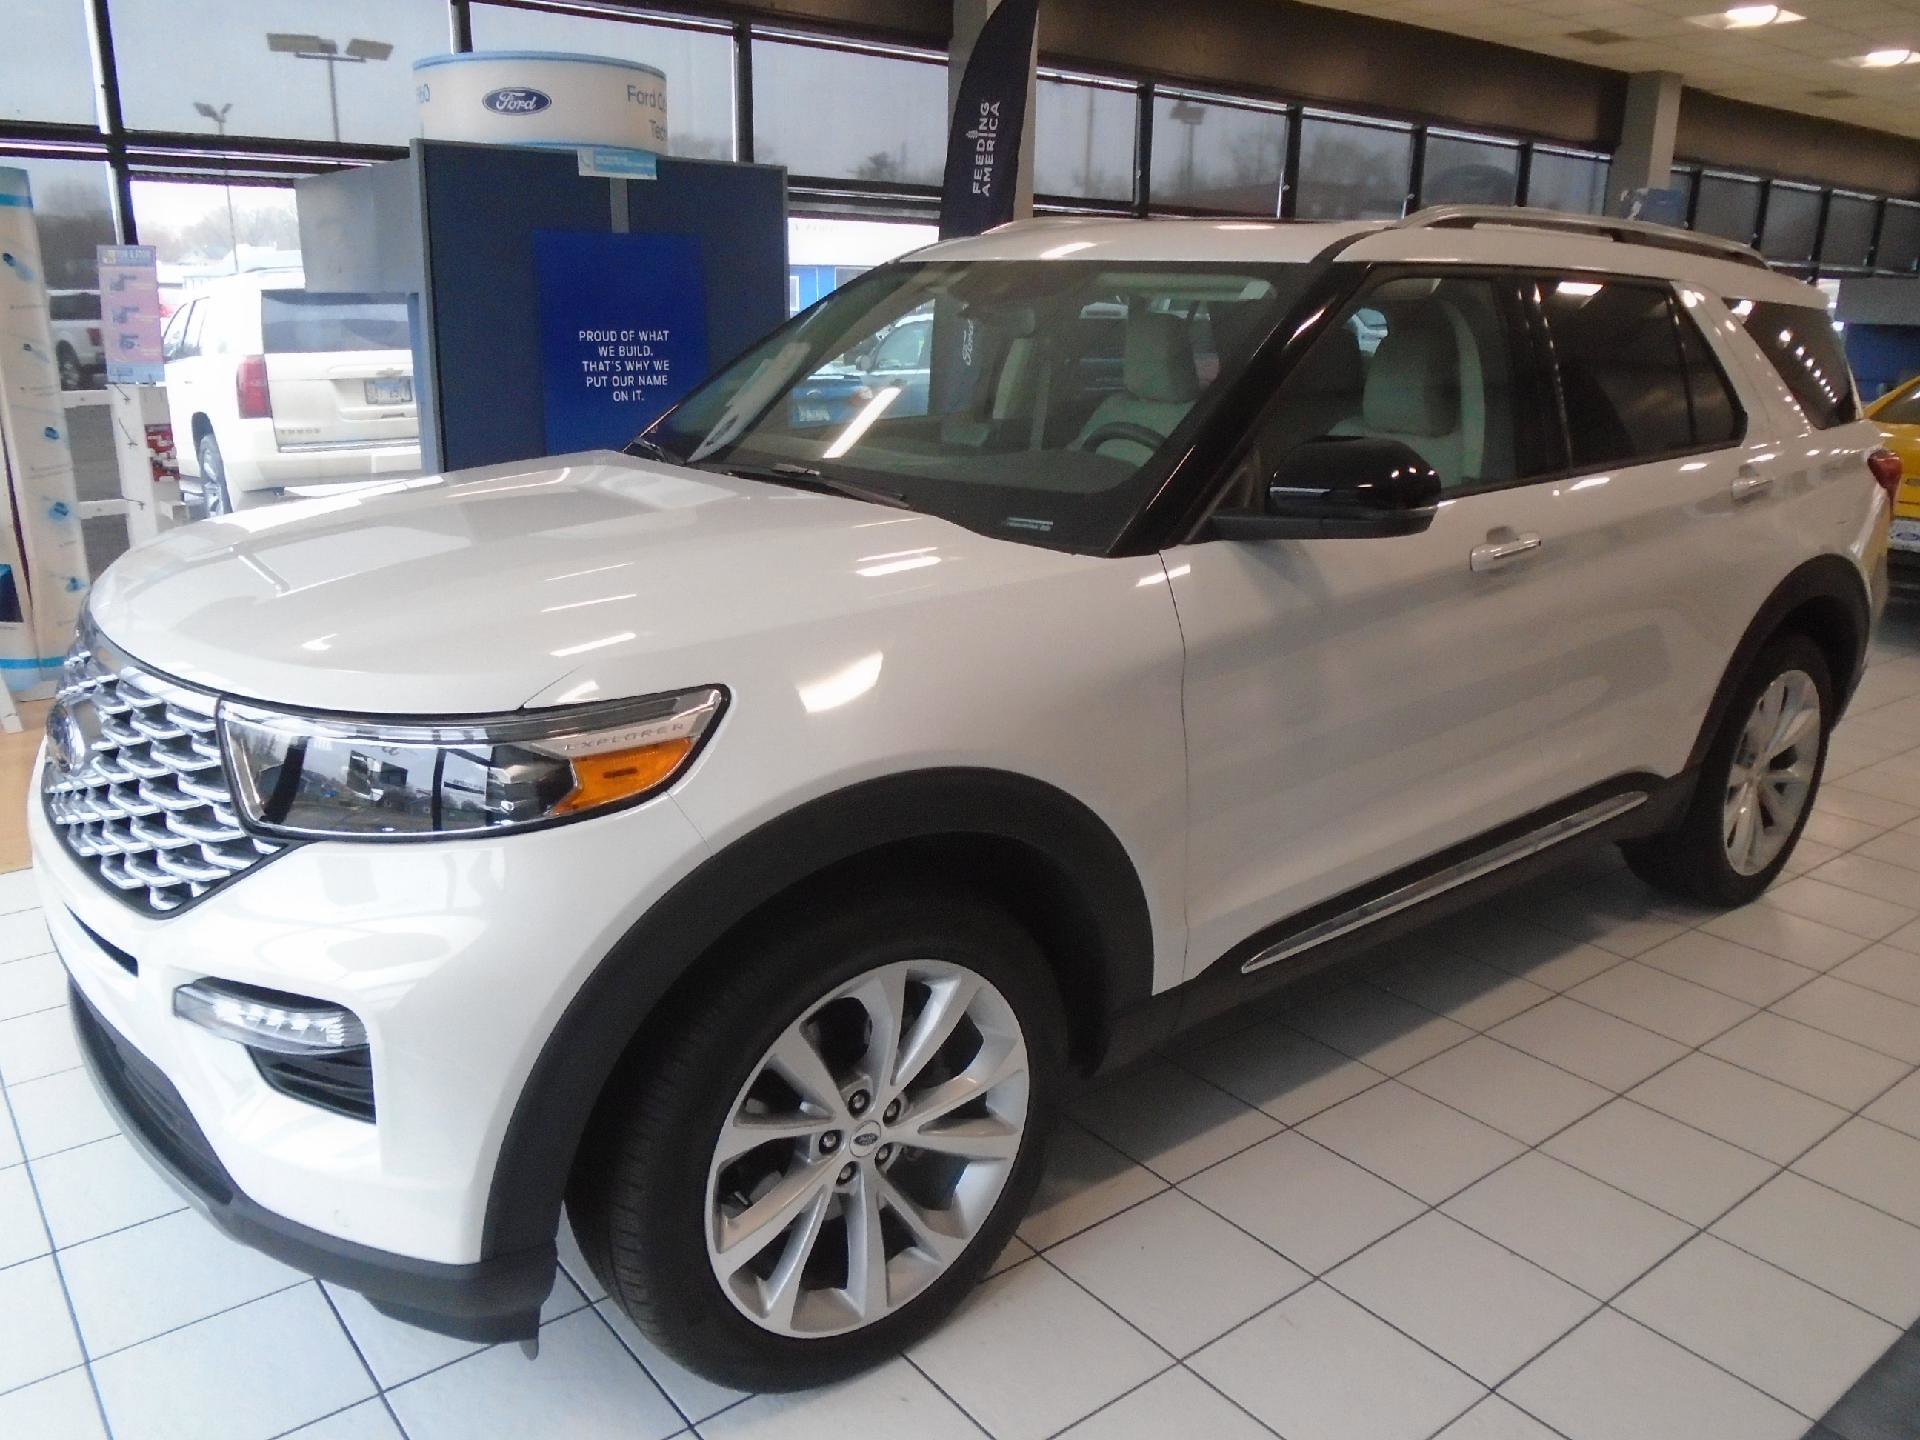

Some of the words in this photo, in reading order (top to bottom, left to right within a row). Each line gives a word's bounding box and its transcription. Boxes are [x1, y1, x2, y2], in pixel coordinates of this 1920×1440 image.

[496, 92, 537, 110] Ford
[627, 84, 656, 107] Ford
[972, 101, 990, 194] FEEDING
[982, 101, 1001, 197] AMERICA
[579, 330, 618, 342] PROUD
[620, 330, 636, 342] OF
[638, 330, 670, 341] WHAT
[598, 346, 615, 357] WE
[618, 345, 654, 357] BUILD.
[582, 360, 622, 372] THAT'S
[624, 360, 650, 371] WHY
[653, 360, 670, 371] WE
[586, 376, 608, 388] PUT
[612, 375, 635, 387] OUR
[638, 374, 668, 386] NAME
[612, 390, 629, 402] ON
[632, 390, 645, 401] IT.
